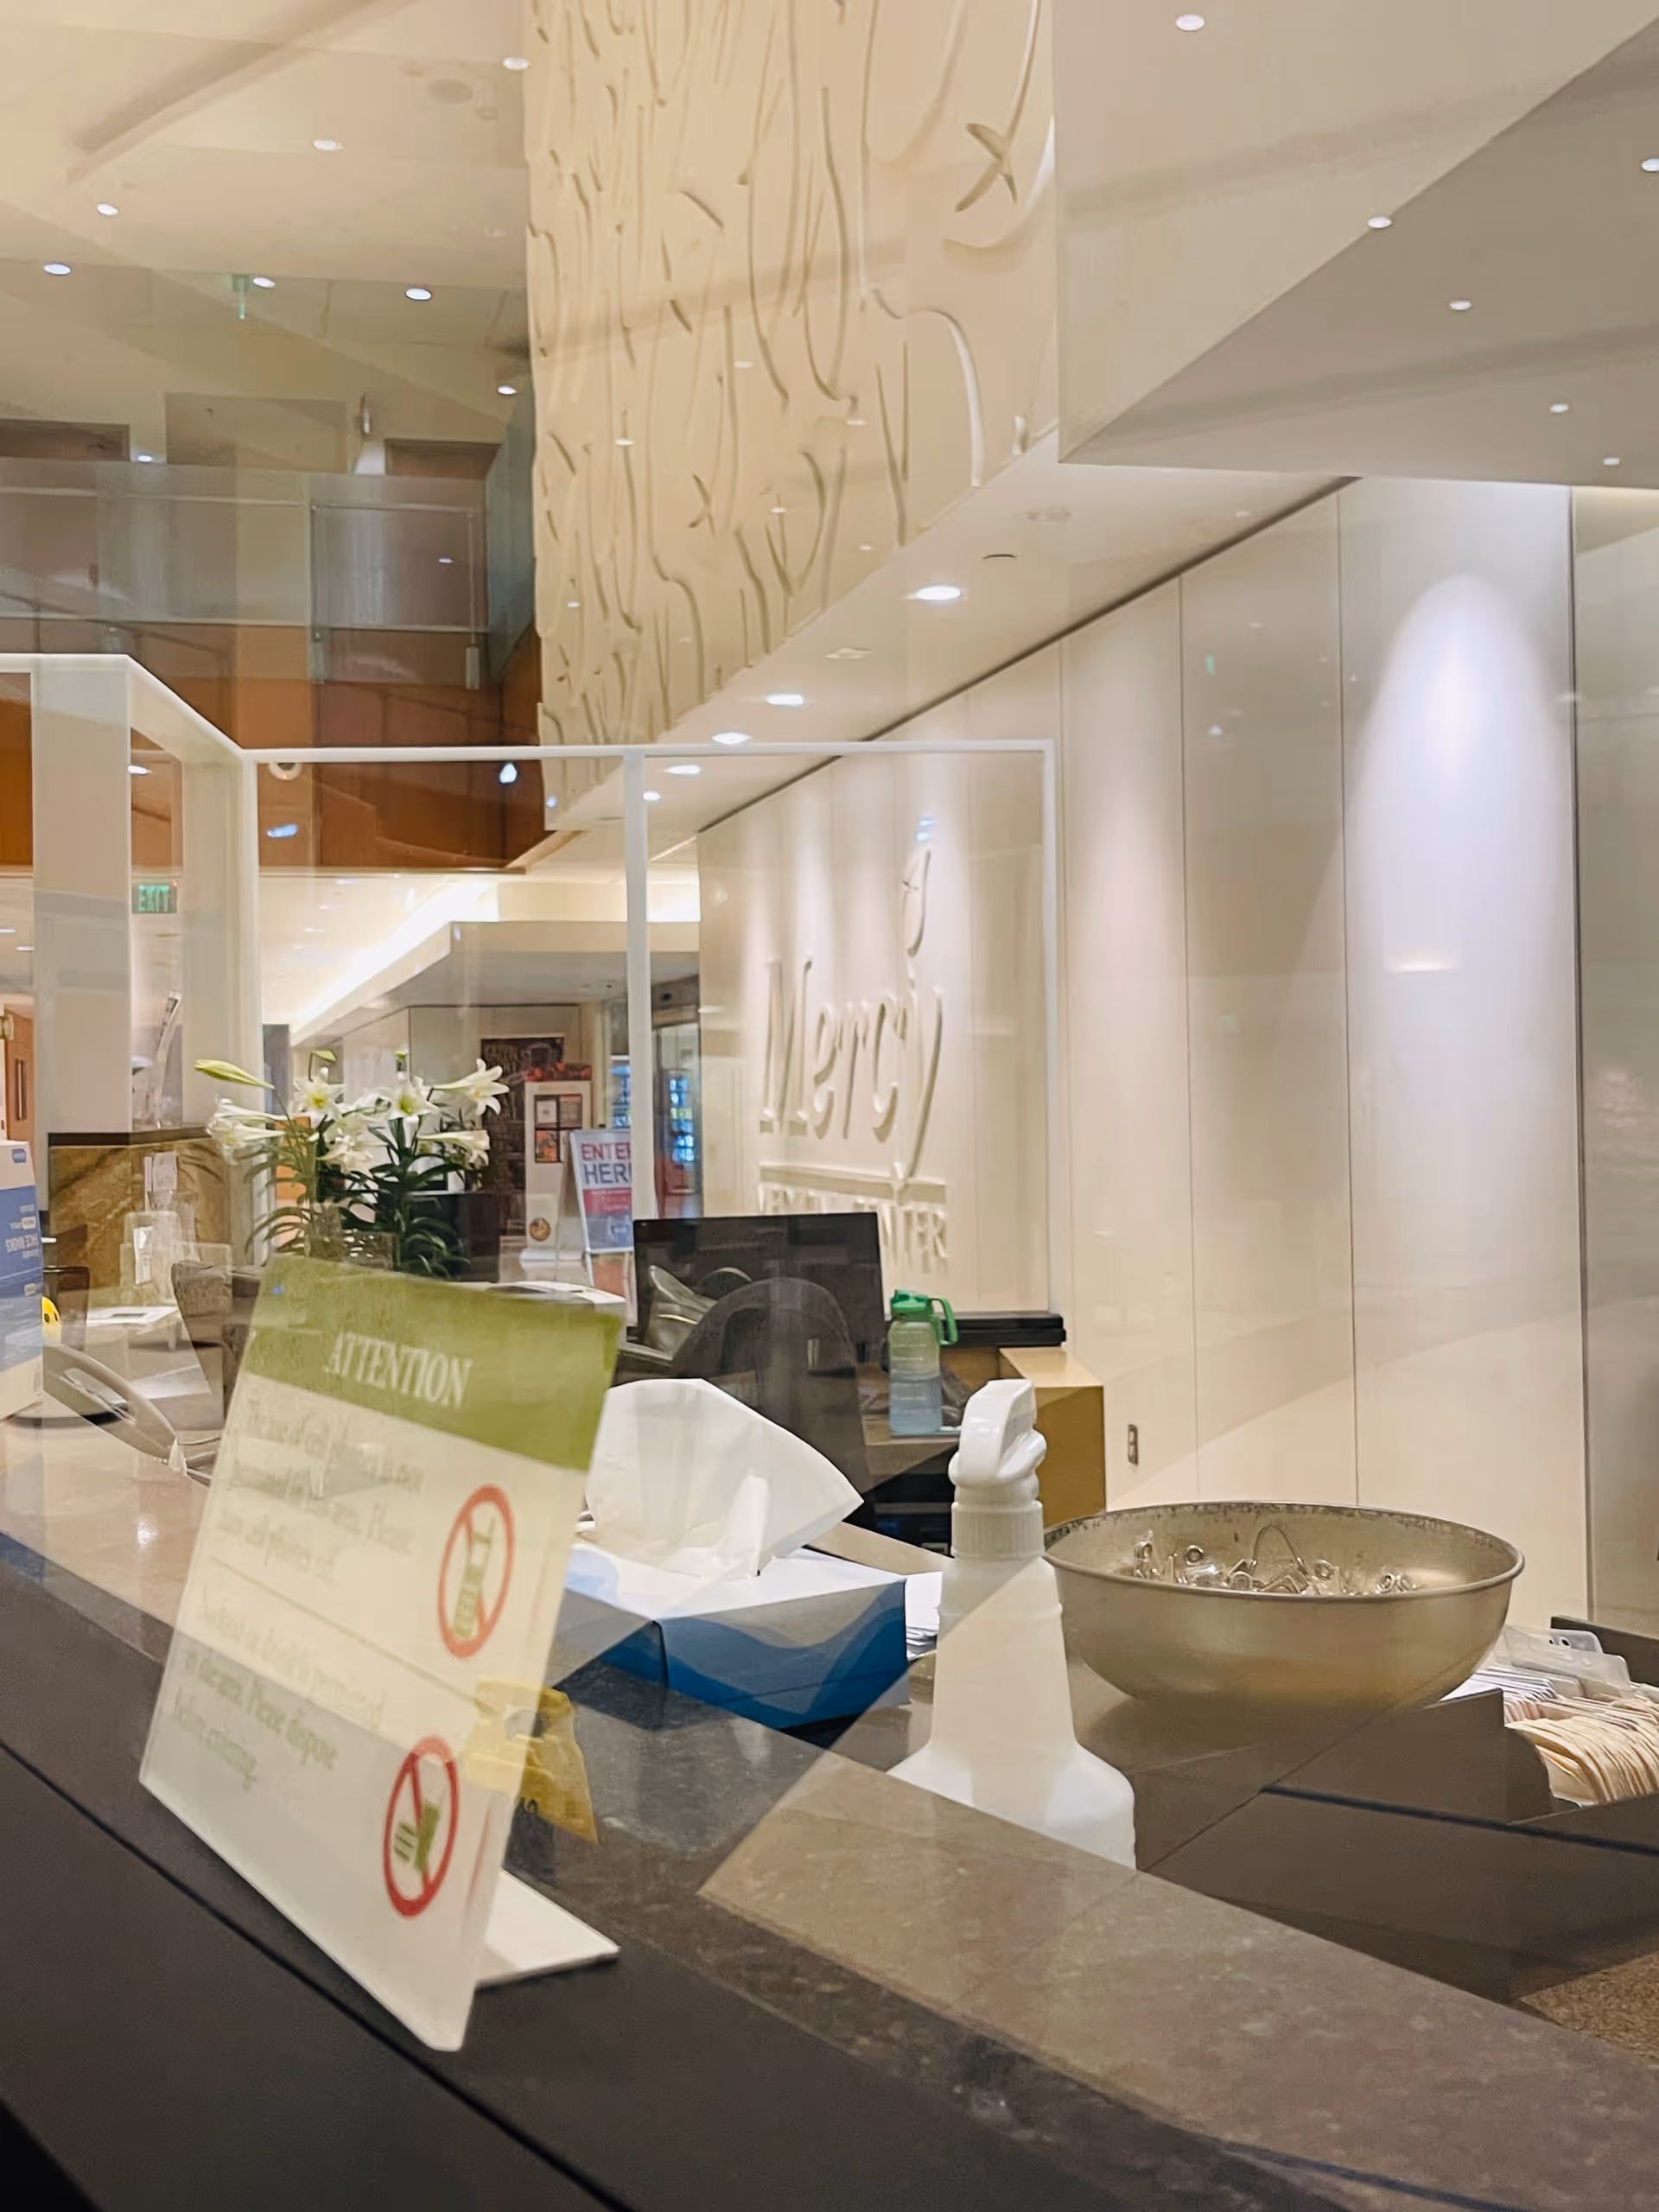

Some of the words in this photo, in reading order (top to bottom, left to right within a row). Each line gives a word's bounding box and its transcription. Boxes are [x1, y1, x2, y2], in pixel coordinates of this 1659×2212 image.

[138, 885, 170, 912] EXIT
[760, 954, 944, 1187] Mercy
[583, 1163, 632, 1184] HER
[324, 1332, 473, 1408] ATTENTION
